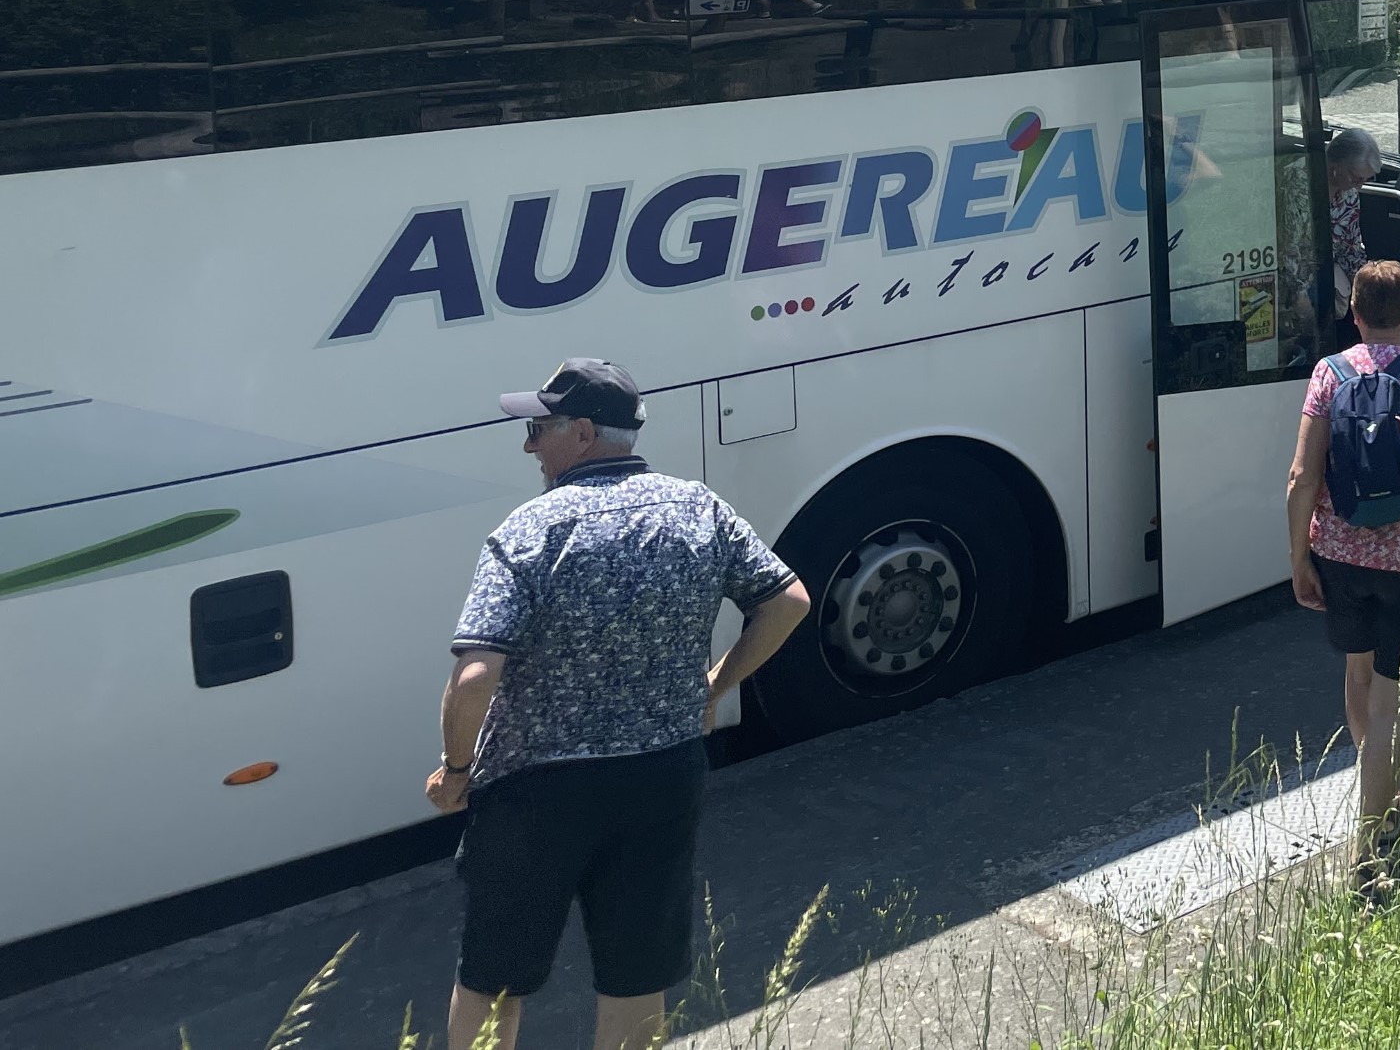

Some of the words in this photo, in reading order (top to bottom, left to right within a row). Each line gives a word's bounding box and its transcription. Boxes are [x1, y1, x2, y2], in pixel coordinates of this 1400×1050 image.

[324, 111, 1204, 344] AUGEREAU
[1222, 245, 1275, 275] 2196
[1241, 275, 1274, 287] ATTENTION
